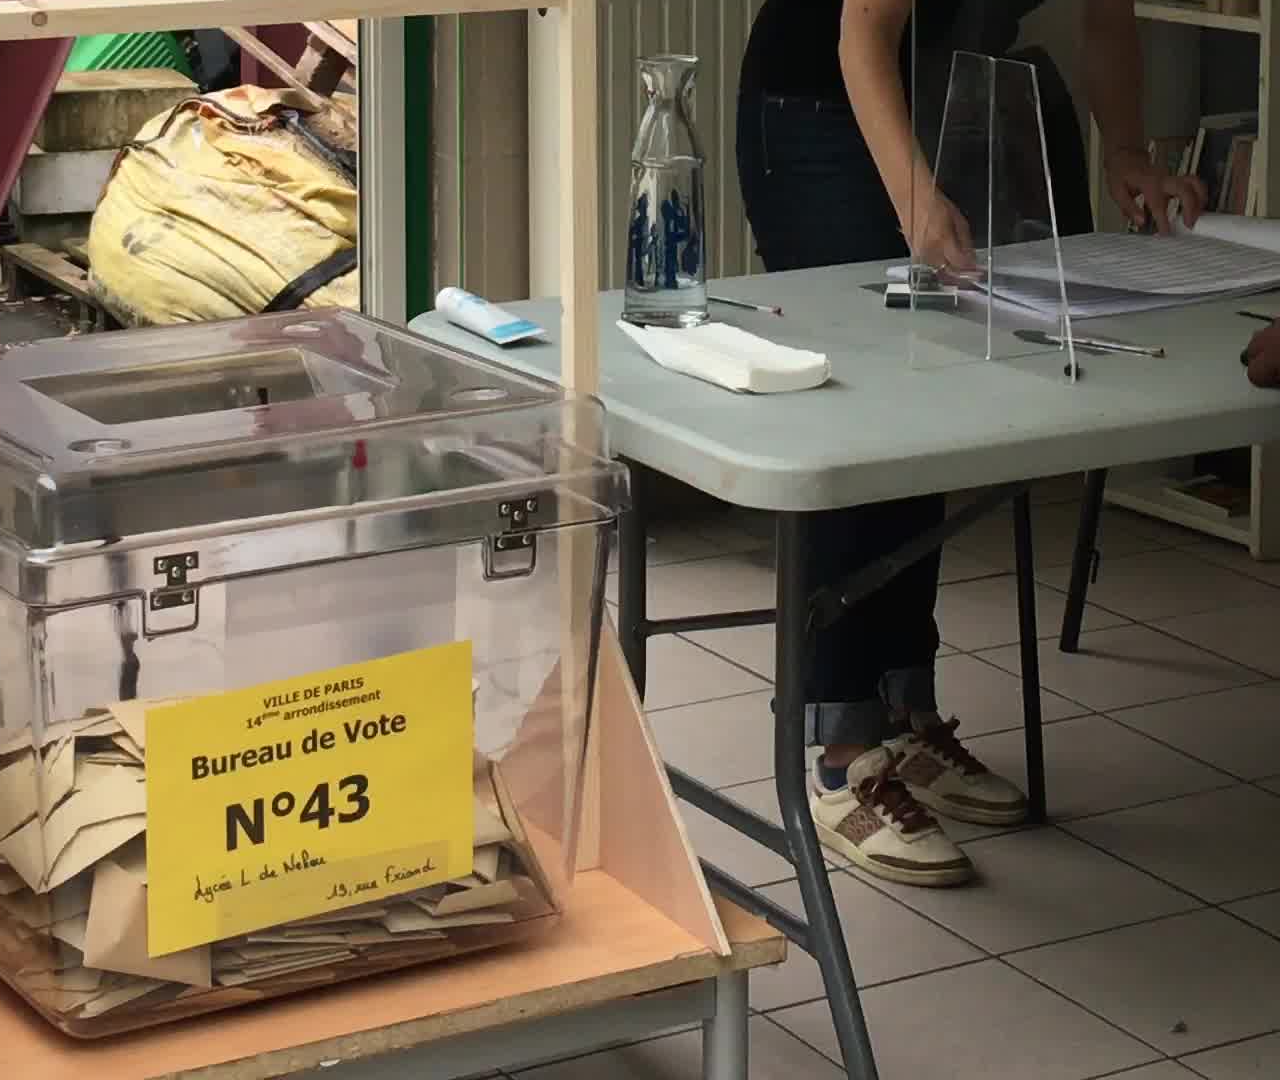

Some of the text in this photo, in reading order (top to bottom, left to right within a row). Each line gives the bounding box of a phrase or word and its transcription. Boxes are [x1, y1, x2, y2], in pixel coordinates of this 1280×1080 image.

[263, 677, 365, 709] VILLE DE PARIS
[283, 689, 382, 720] arrondissement
[191, 713, 407, 780] Bureau de Vote
[225, 774, 371, 852] N°43
[259, 864, 278, 881] de
